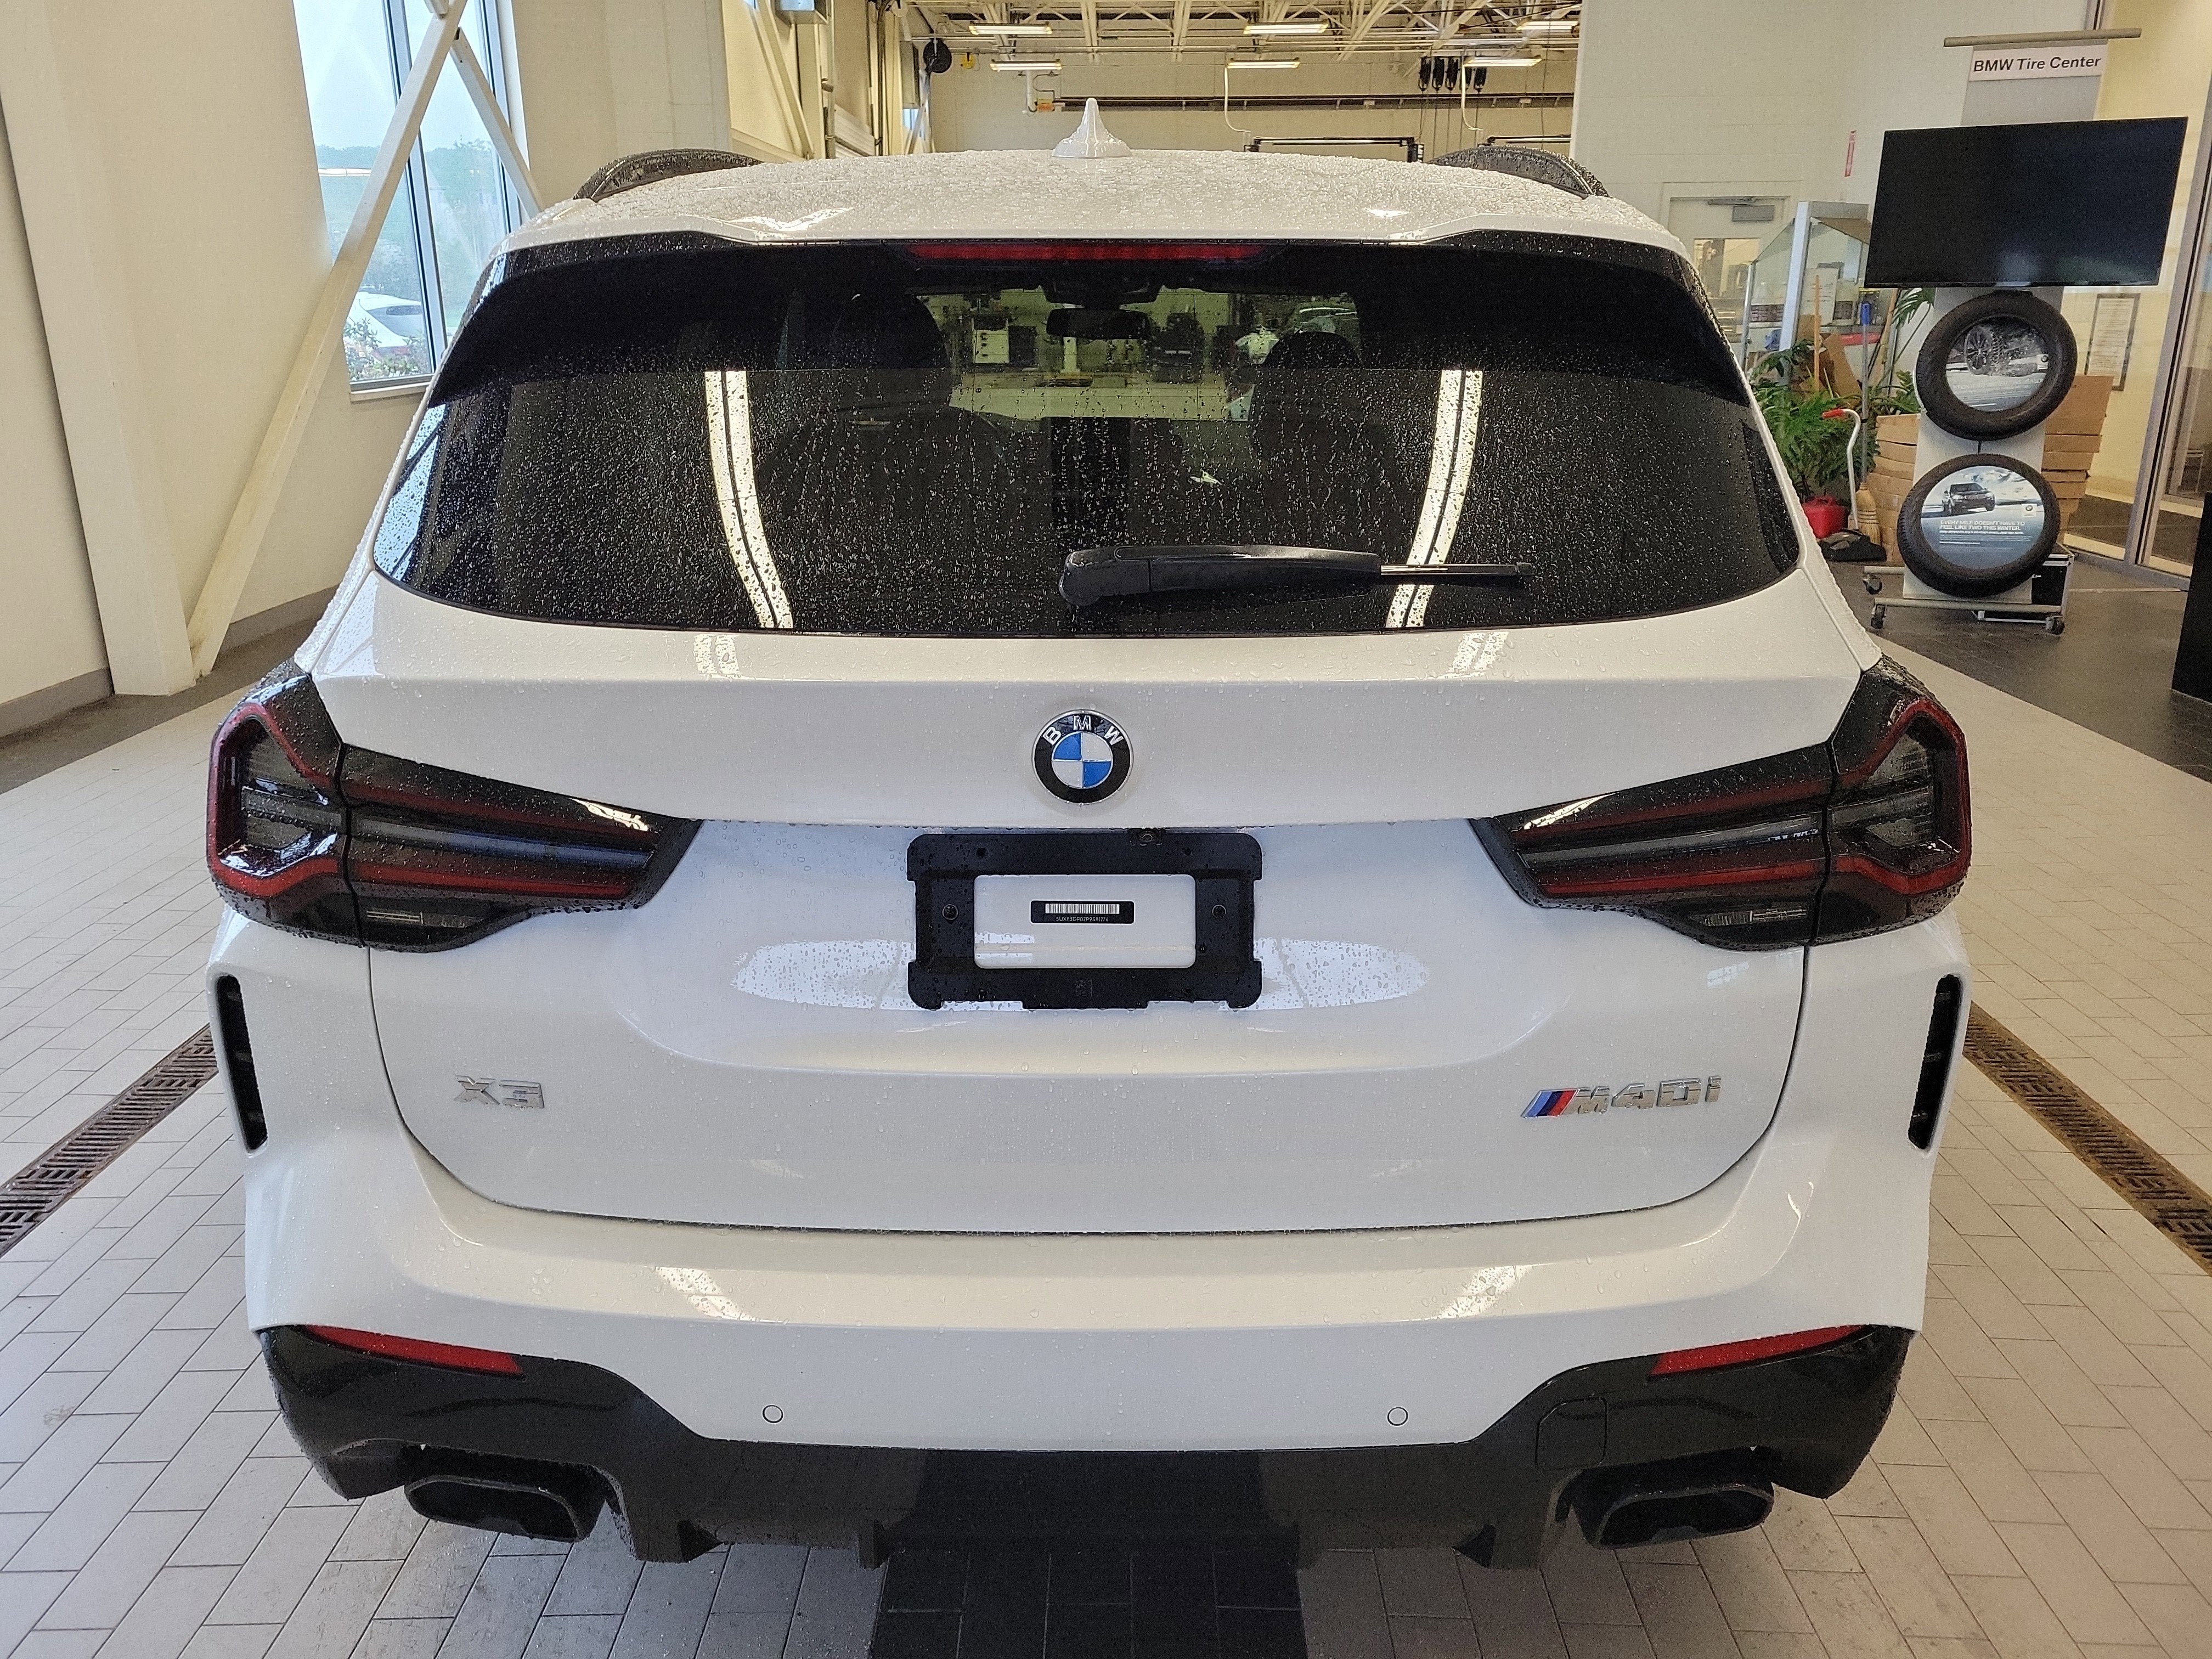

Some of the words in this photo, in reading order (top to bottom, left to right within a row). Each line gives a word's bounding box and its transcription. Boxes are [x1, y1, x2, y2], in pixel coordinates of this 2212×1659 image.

[1973, 59, 2014, 72] BMW
[2017, 58, 2045, 70] Tire
[2050, 57, 2101, 69] Center
[1042, 715, 1123, 746] BMW
[454, 1075, 544, 1109] X3
